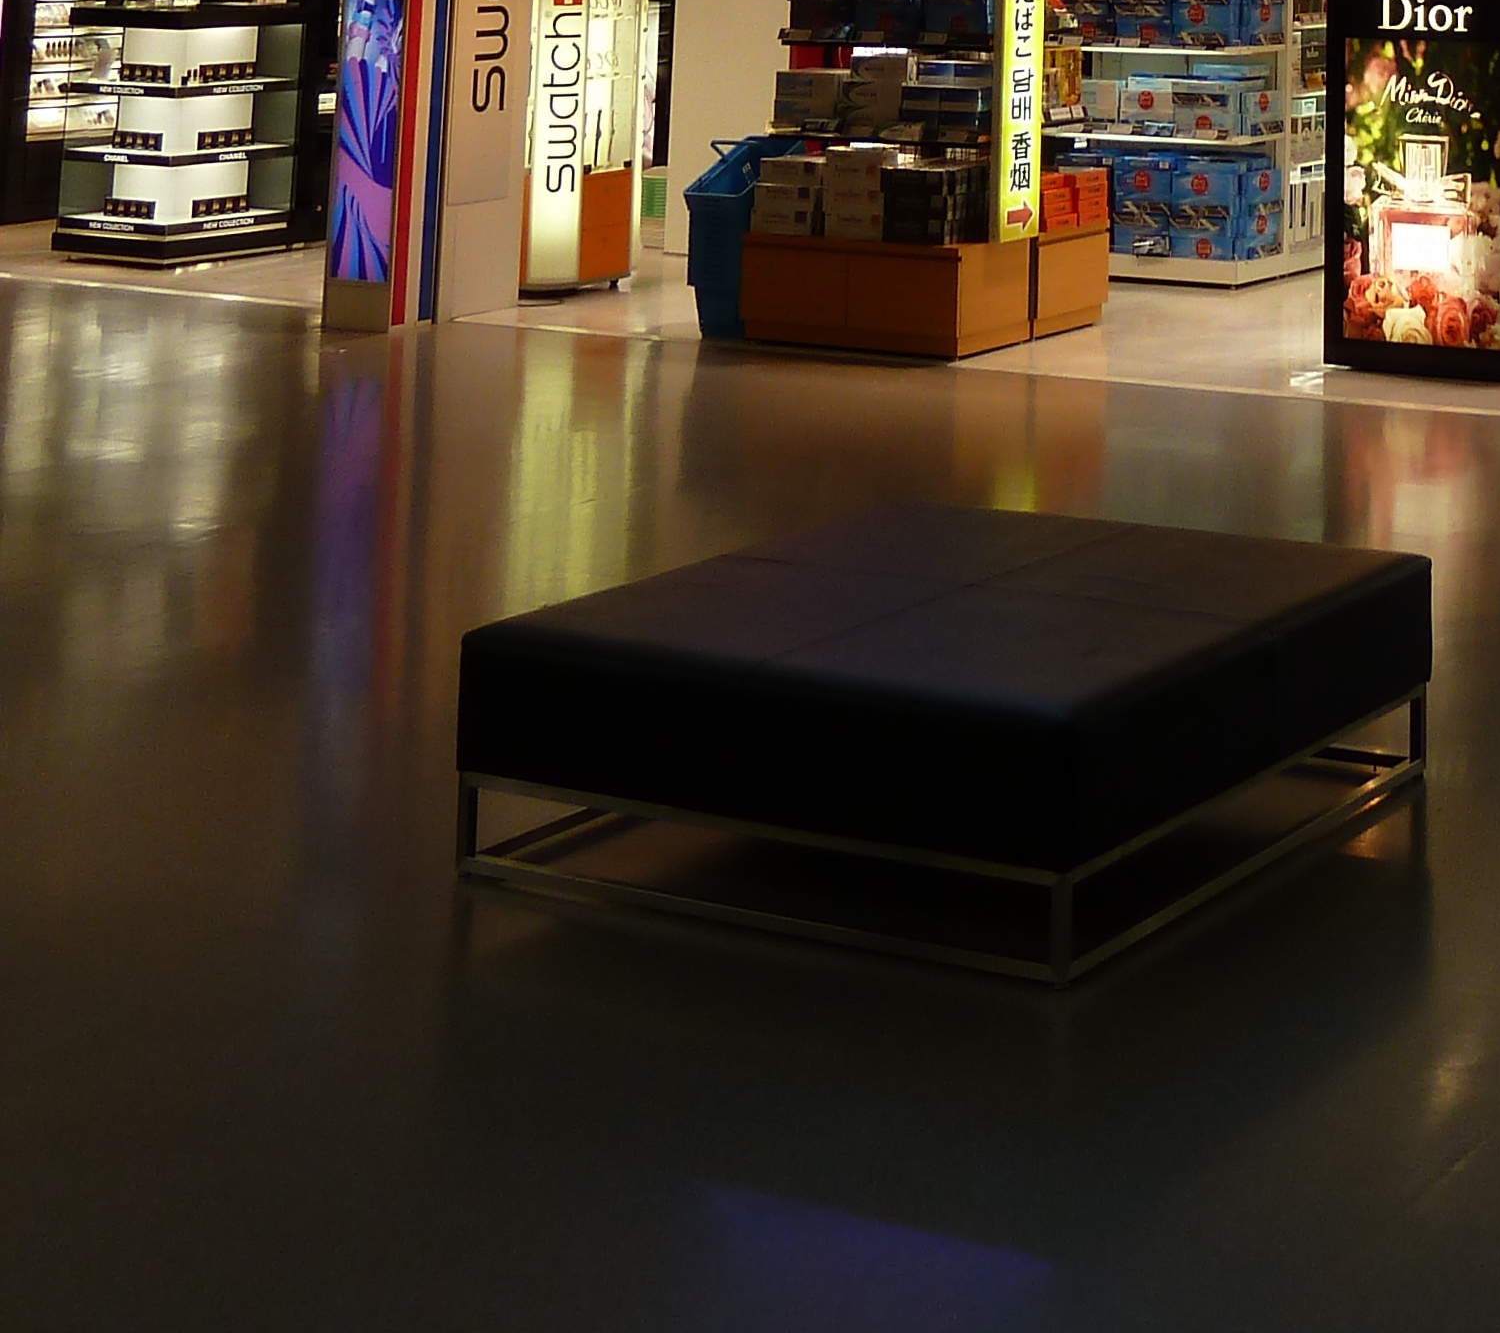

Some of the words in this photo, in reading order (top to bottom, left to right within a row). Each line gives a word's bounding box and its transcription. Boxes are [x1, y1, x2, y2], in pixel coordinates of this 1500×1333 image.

[543, 12, 583, 193] swatch
[1011, 67, 1034, 121] 담배
[1010, 131, 1032, 192] 香烟
